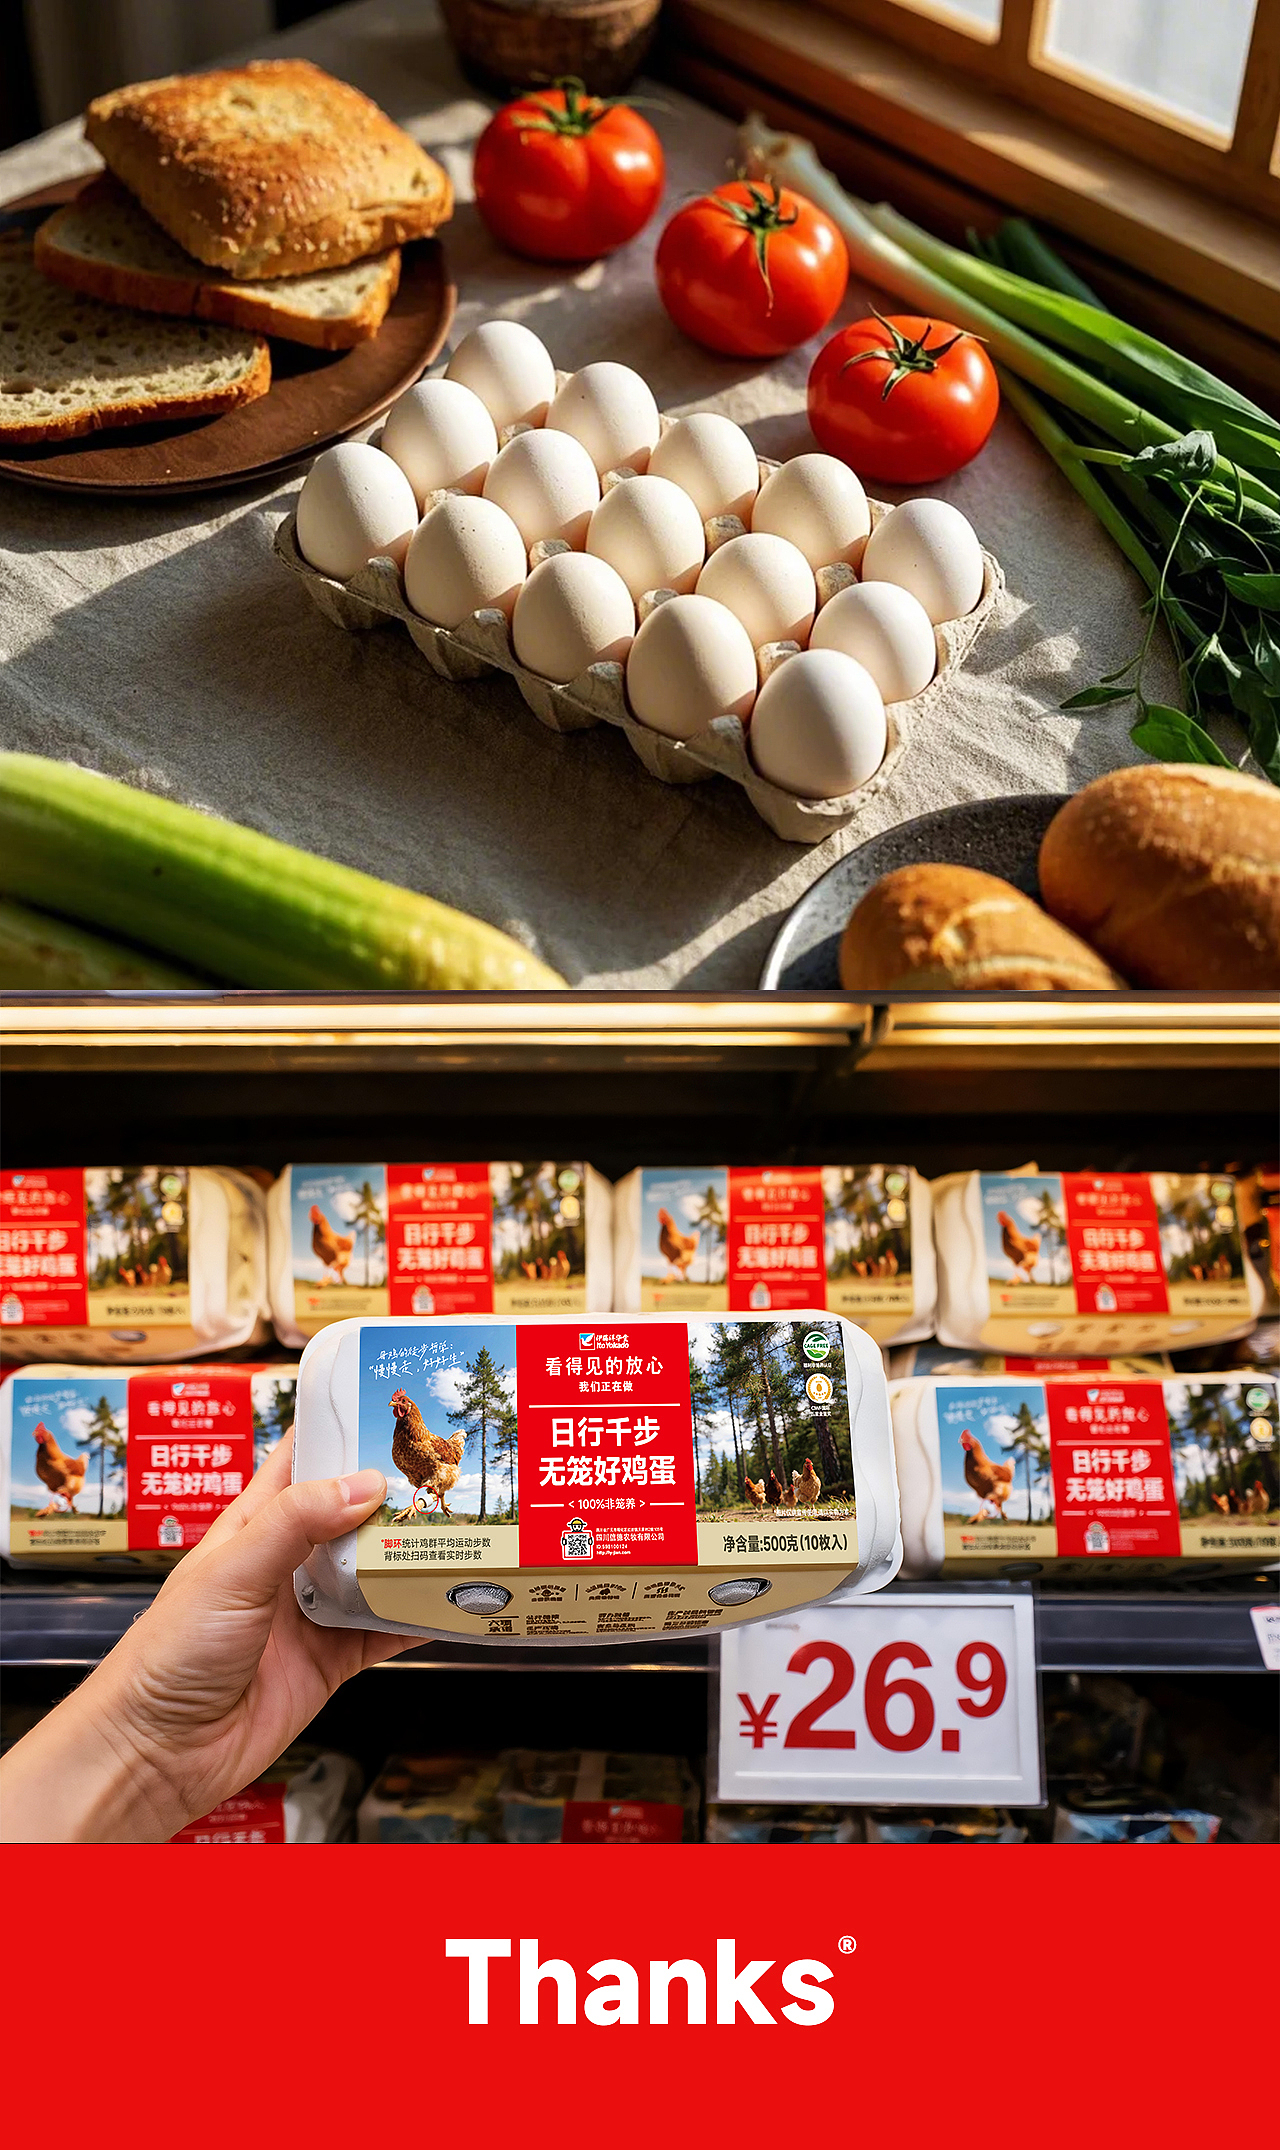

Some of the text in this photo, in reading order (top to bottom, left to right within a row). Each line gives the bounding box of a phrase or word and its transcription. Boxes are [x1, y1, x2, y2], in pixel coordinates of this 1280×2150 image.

[545, 1356, 664, 1376] 看得见的放心
[579, 1381, 634, 1392] 我们正在做
[551, 1415, 661, 1448] 日行千步
[150, 1444, 233, 1468] 日行千步
[1072, 1448, 1152, 1474] 日行千步
[538, 1454, 677, 1487] 无笼好鸡蛋
[141, 1471, 243, 1496] 无笼好鸡蛋
[723, 1534, 848, 1553] 净含量:500克(10枚入)
[383, 1550, 482, 1562] 背标处扫码查看实时步数
[736, 1639, 1008, 1753] ¥26.9
